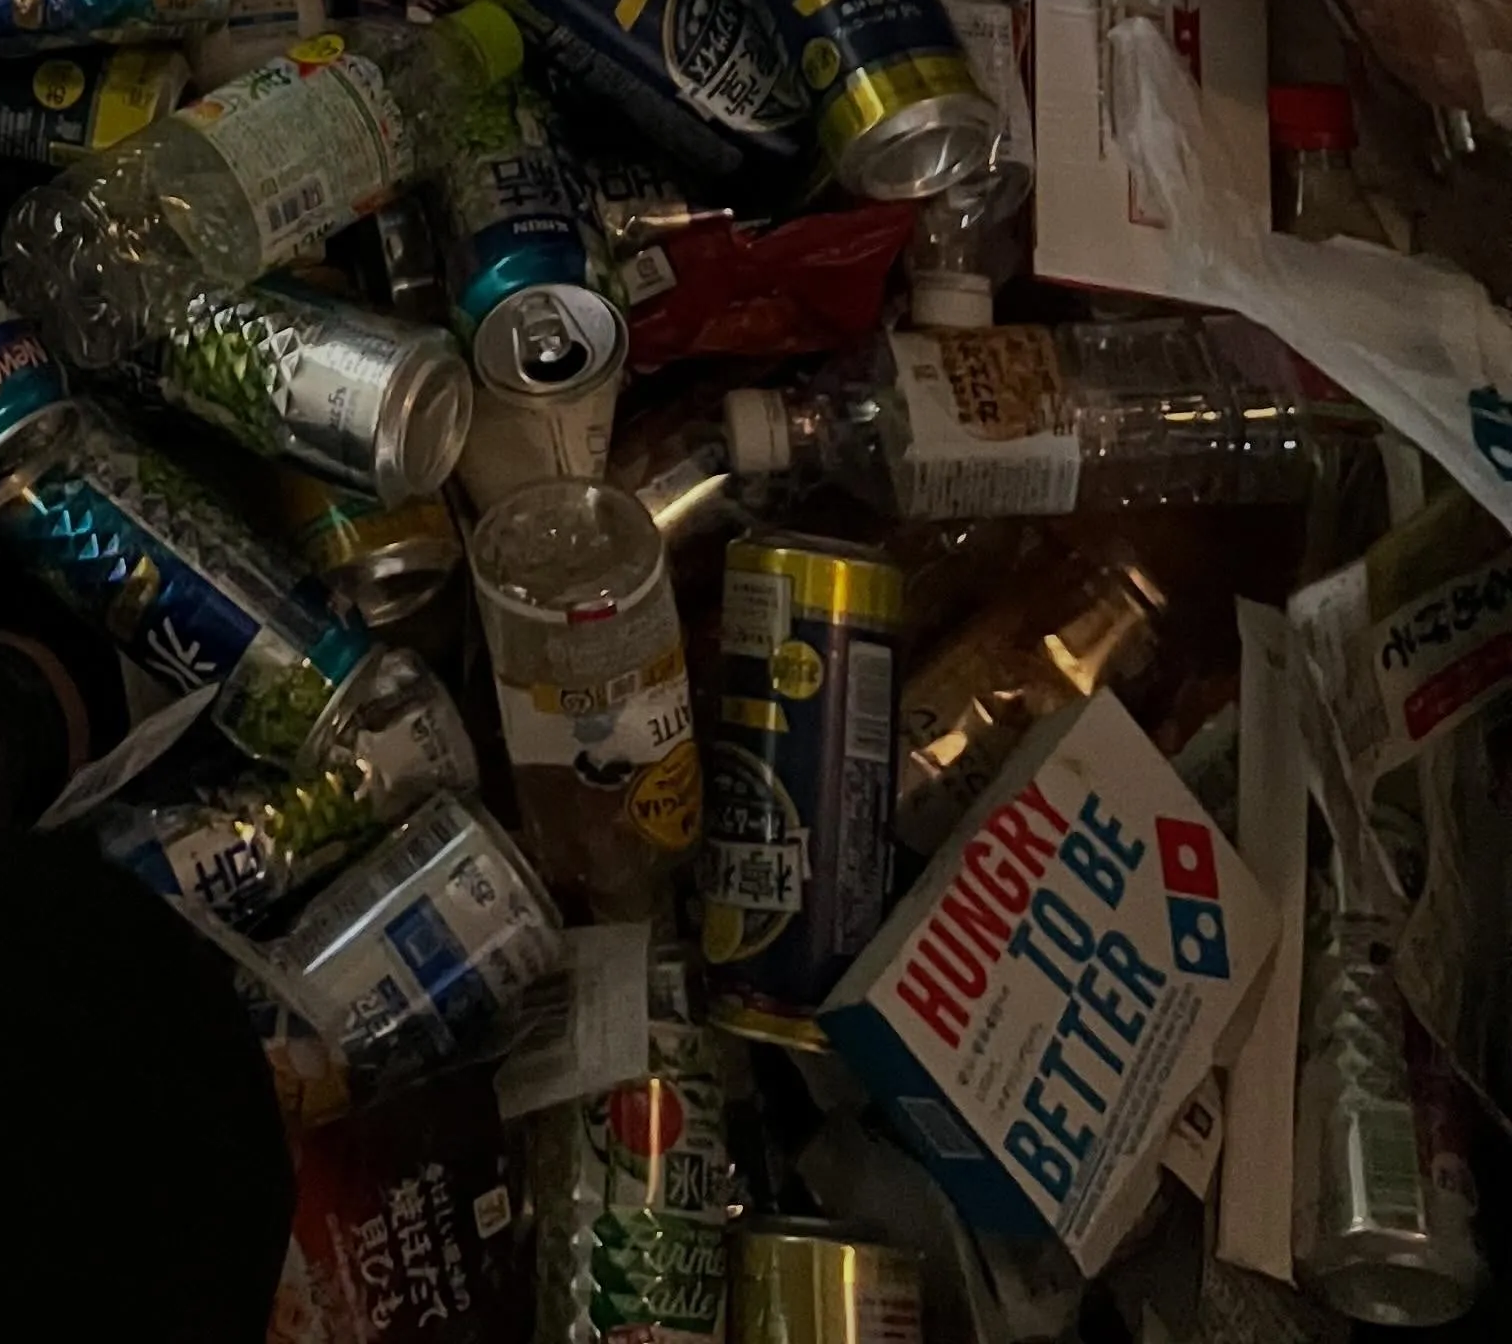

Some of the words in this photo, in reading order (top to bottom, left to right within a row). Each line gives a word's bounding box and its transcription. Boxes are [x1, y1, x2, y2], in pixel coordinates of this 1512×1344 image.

[896, 781, 1071, 1050] HUNGRY
[1007, 888, 1097, 996] TO
[1058, 791, 1147, 912] BE
[1003, 930, 1168, 1203] BETTER
